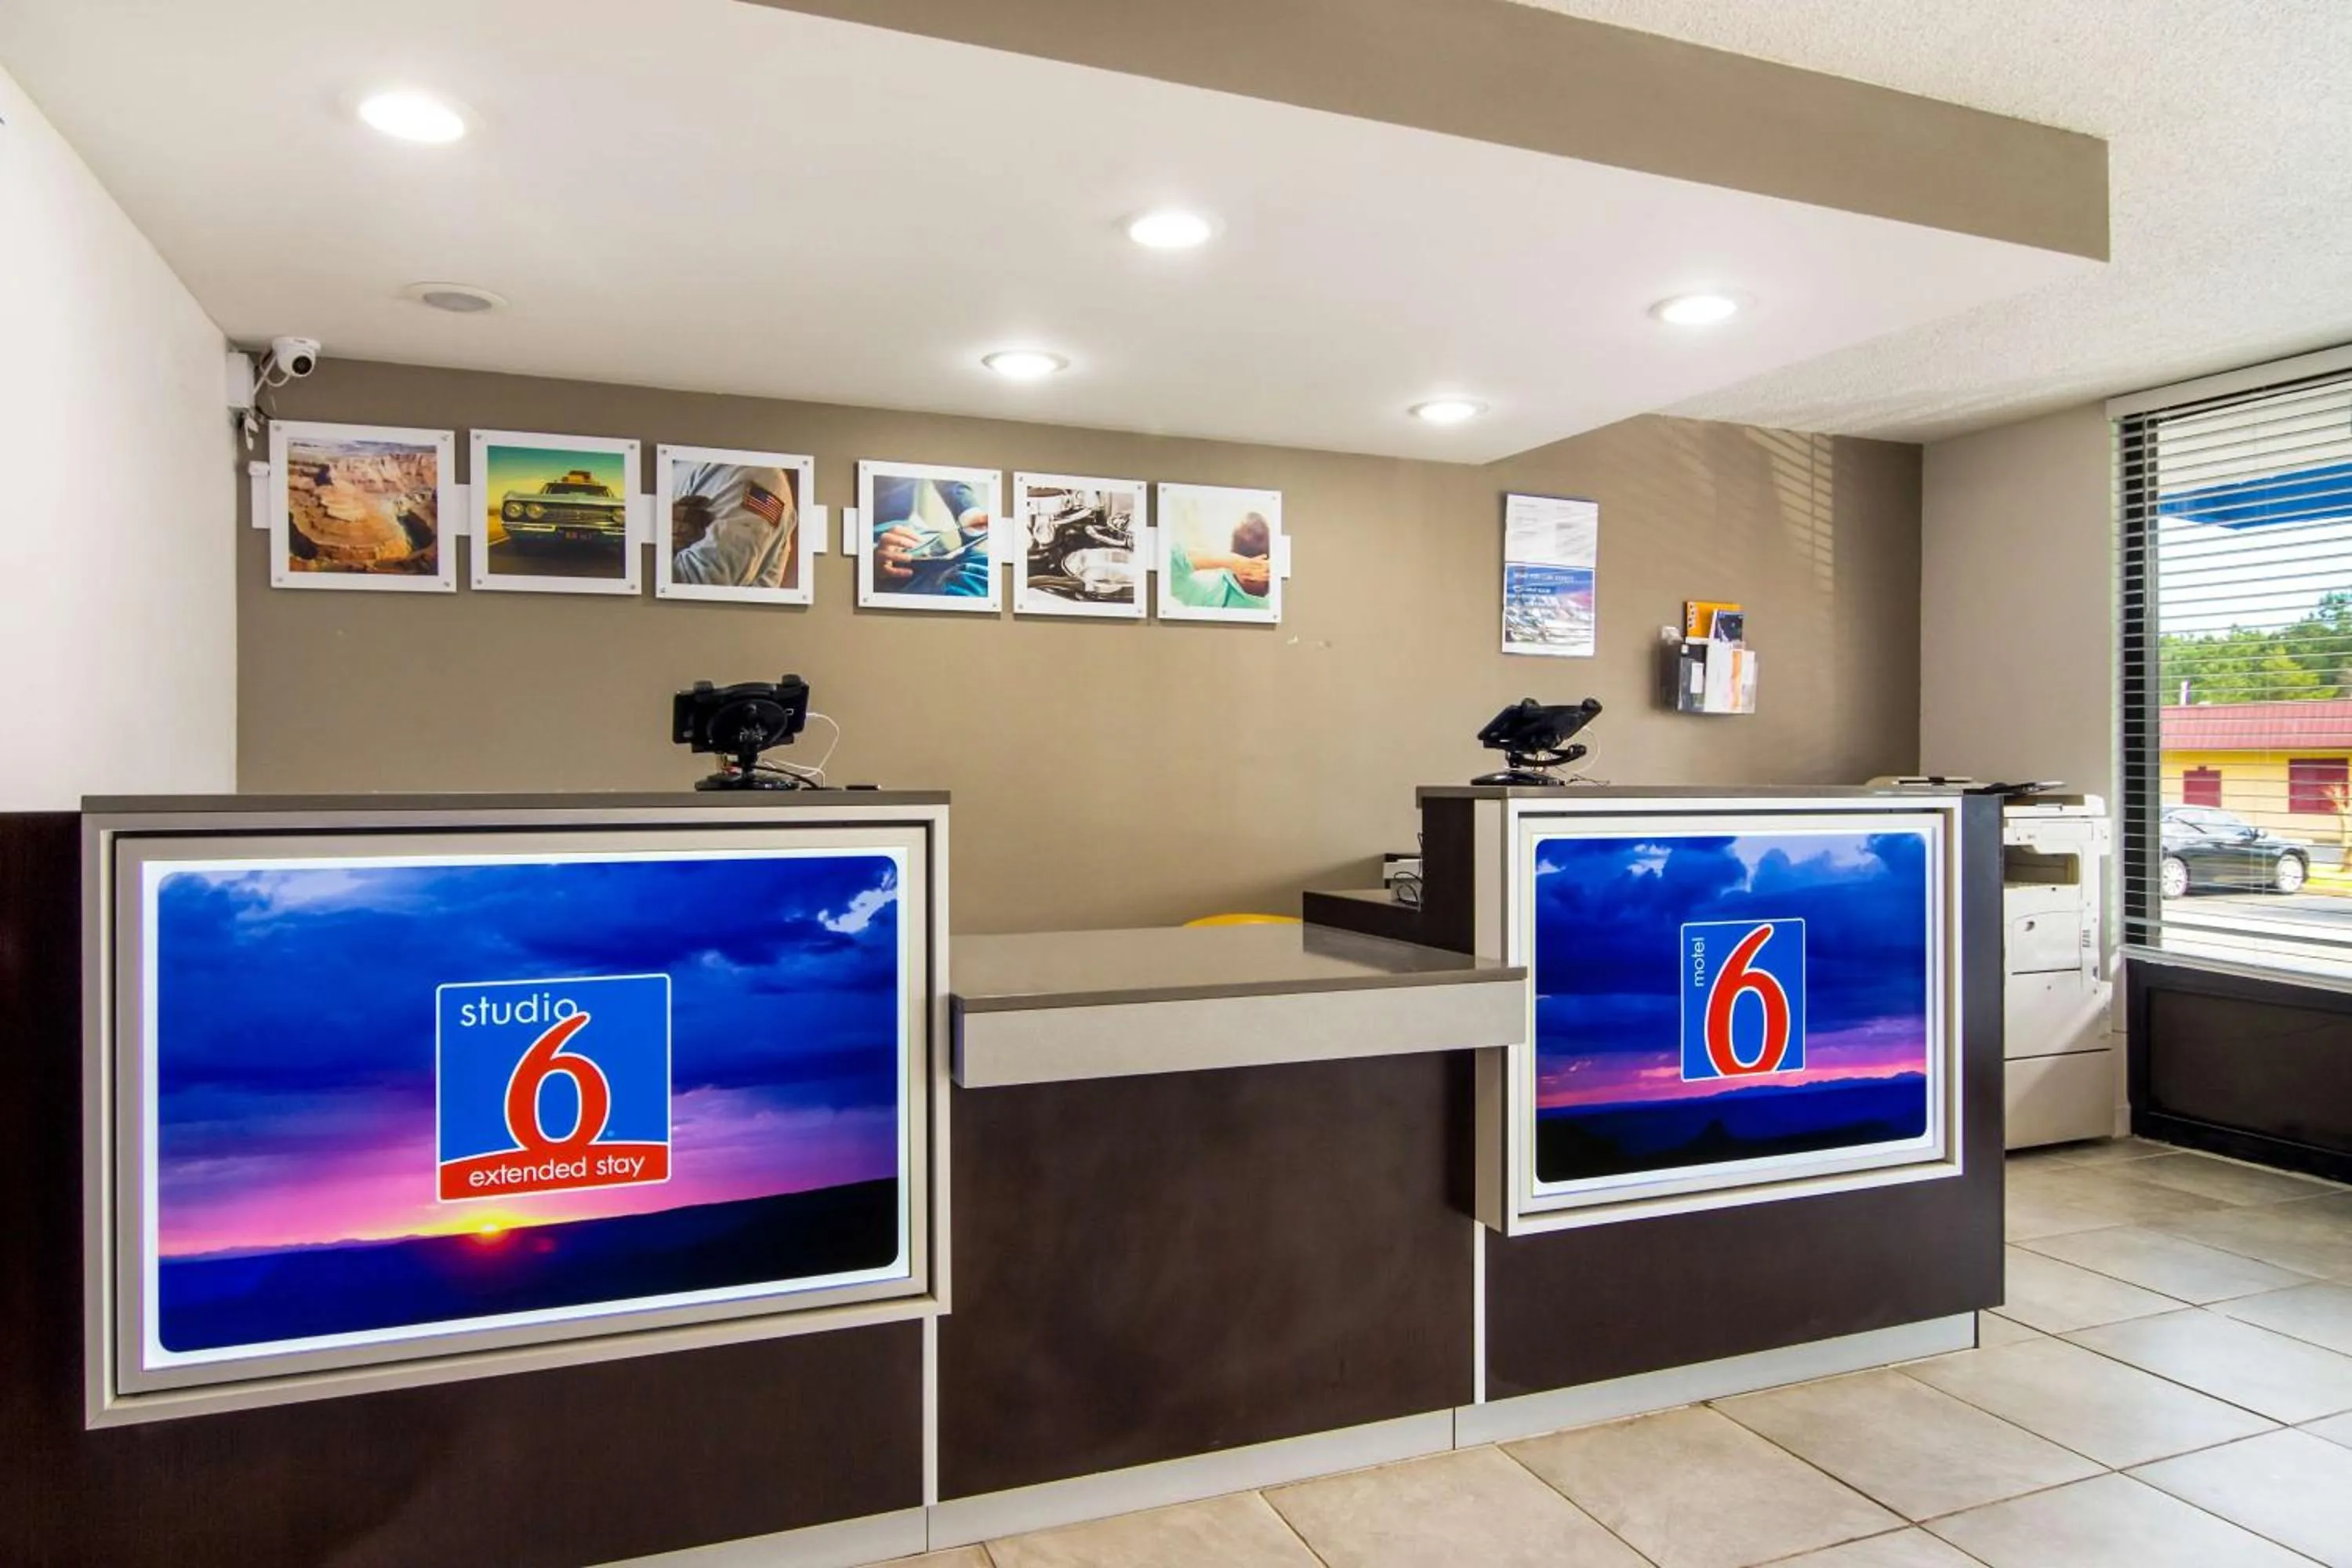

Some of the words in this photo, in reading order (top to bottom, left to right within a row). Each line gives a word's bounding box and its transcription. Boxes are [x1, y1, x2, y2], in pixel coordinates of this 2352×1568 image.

[459, 992, 578, 1027] studio
[1691, 937, 1705, 988] motel
[1704, 923, 1791, 1076] 6
[503, 1011, 612, 1150] 6
[468, 1156, 587, 1187] extended
[595, 1154, 646, 1177] stay
